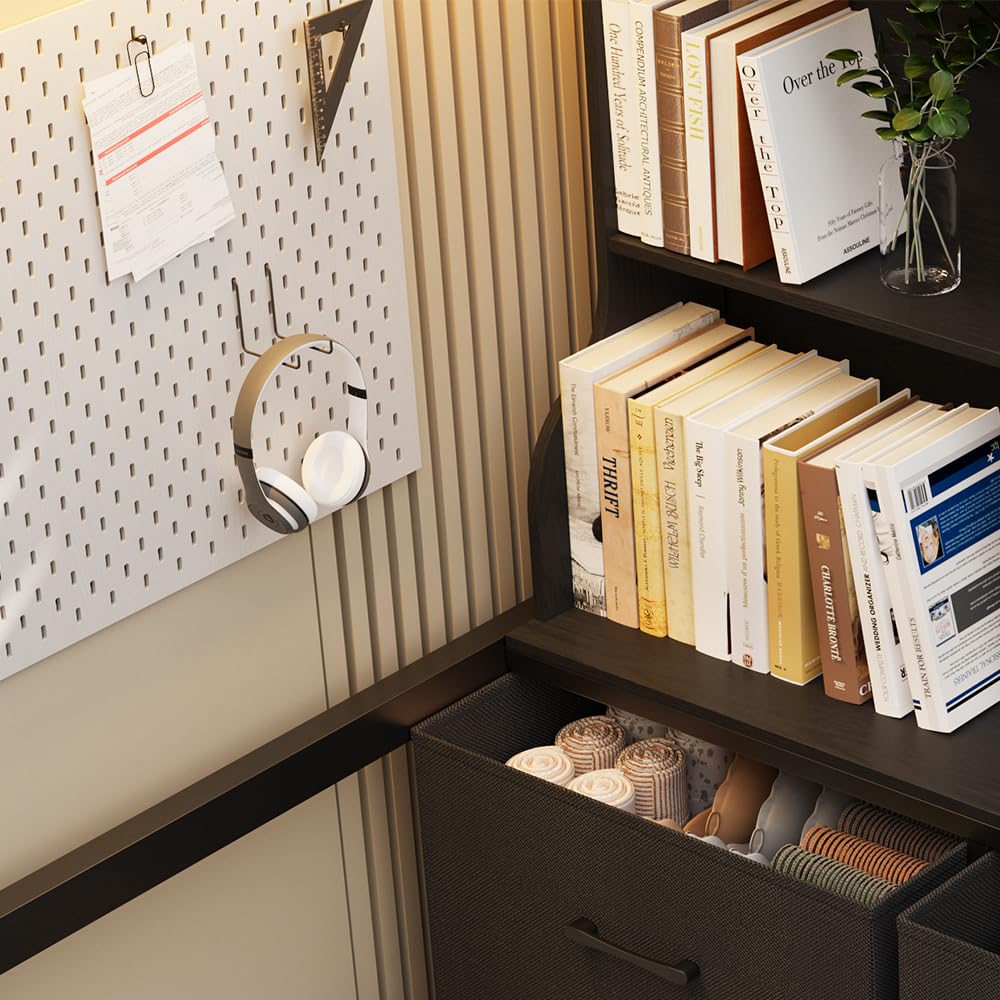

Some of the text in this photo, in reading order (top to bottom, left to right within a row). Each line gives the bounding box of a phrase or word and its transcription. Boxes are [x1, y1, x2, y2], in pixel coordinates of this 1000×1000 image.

[609, 23, 631, 171] One Hundred Years of Solitude
[686, 42, 704, 141] LOST FISH
[783, 71, 813, 95] Over
[816, 60, 836, 81] the
[634, 20, 653, 216] COMPENDIUM ARCHITECTURAL ANTIQUES
[781, 247, 791, 274] ASSOULINE
[843, 236, 870, 255] ASSOULINE
[602, 457, 619, 519] THRIFT
[694, 441, 705, 488] The Big Sleep
[736, 448, 744, 483] Wilkinson
[664, 480, 680, 569] WILHELM BUSCH
[820, 564, 836, 622] CHARLOTTE
[863, 573, 876, 616] ORGANIZER
[870, 617, 881, 651] WEDDING
[910, 617, 932, 699] TRAIN FOR RESULTS
